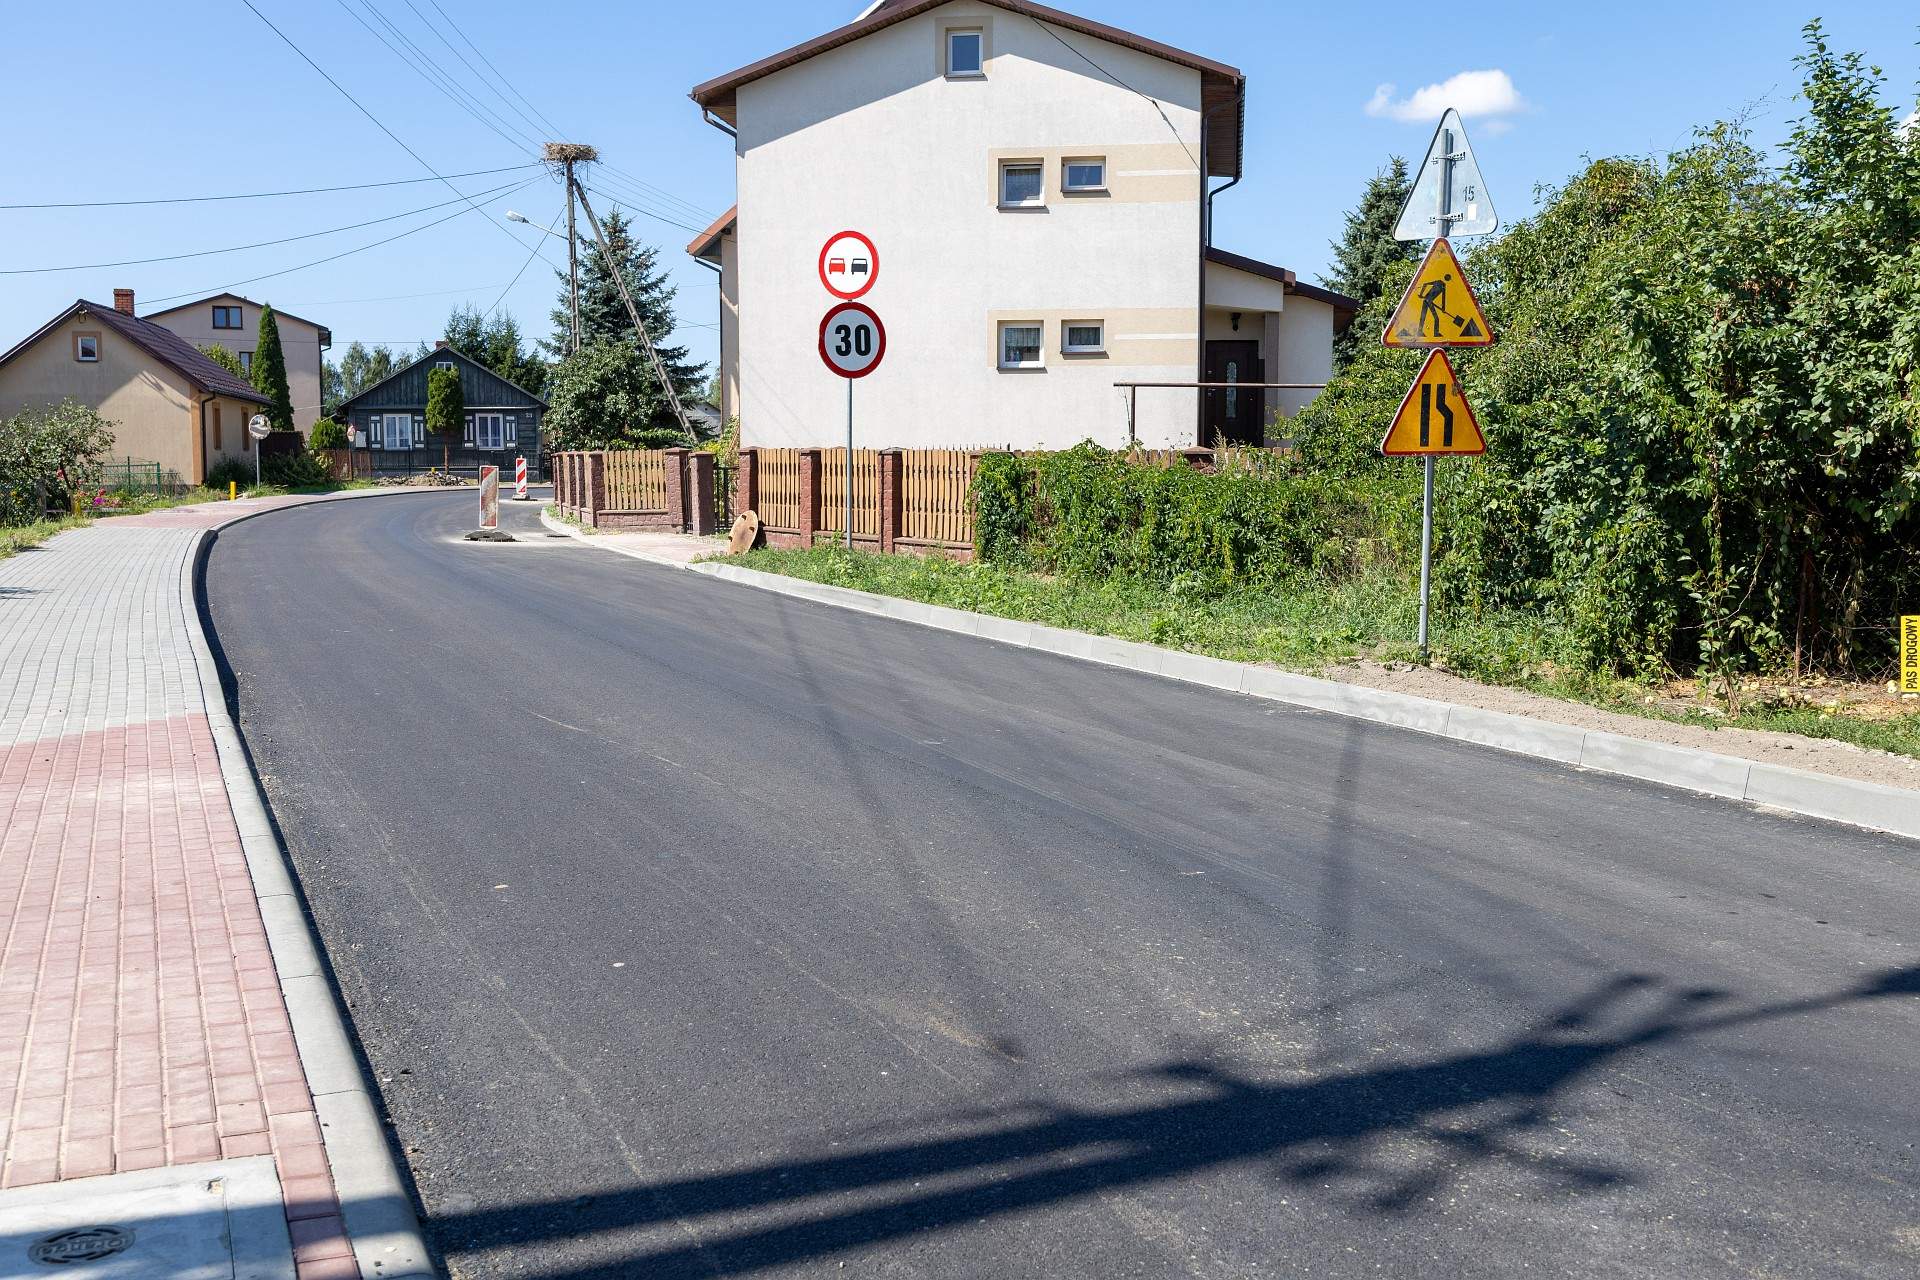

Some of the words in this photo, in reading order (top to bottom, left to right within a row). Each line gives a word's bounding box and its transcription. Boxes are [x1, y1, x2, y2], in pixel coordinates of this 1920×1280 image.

[835, 324, 871, 357] 30
[1905, 618, 1918, 668] DROGOWY
[1905, 671, 1918, 689] PAS
